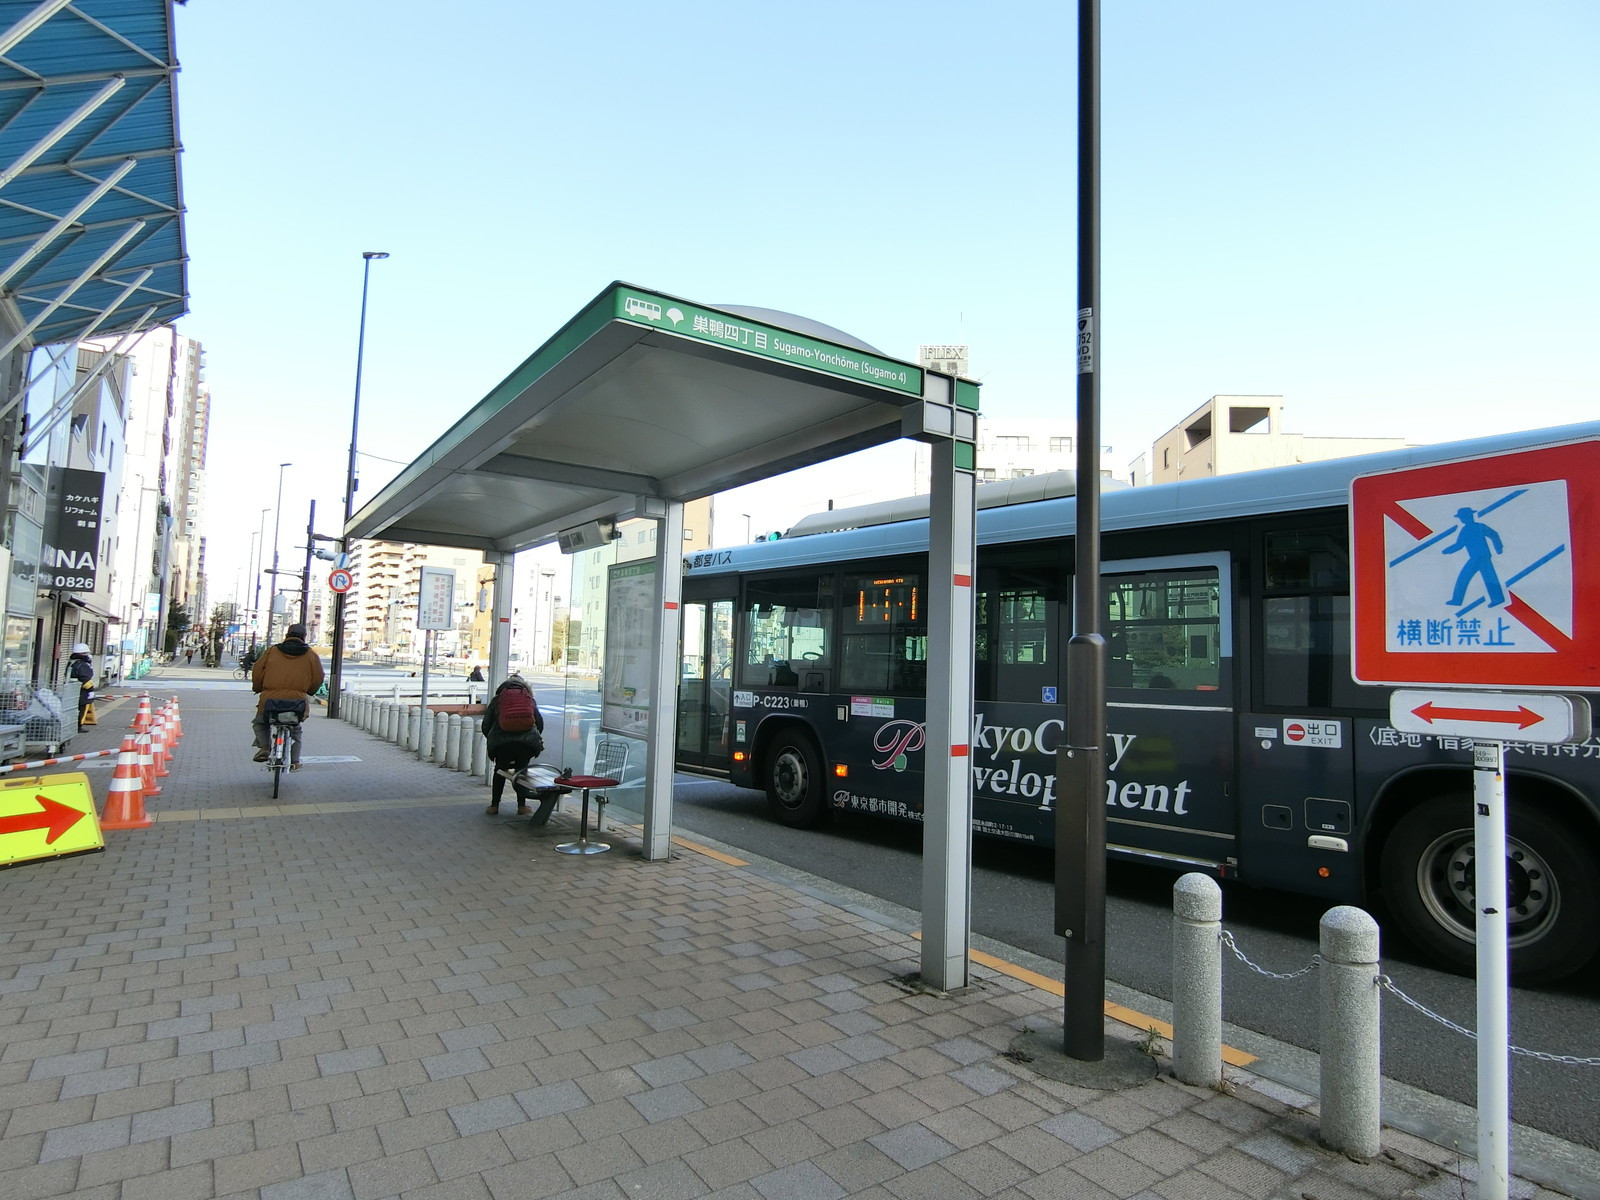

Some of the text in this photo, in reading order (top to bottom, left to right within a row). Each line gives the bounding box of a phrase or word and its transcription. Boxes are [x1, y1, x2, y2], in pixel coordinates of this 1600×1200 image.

[692, 314, 907, 385] 巣鴨四丁目 Sugamo-Yonchōme (Sugamo 4)
[924, 347, 964, 360] FLEX
[66, 494, 99, 504] カケハギ
[64, 506, 98, 516] リフォーム
[693, 550, 732, 568] 都営バス
[1396, 618, 1515, 647] 横断禁止
[1307, 723, 1338, 736] 出口
[1310, 737, 1333, 745] EXIT
